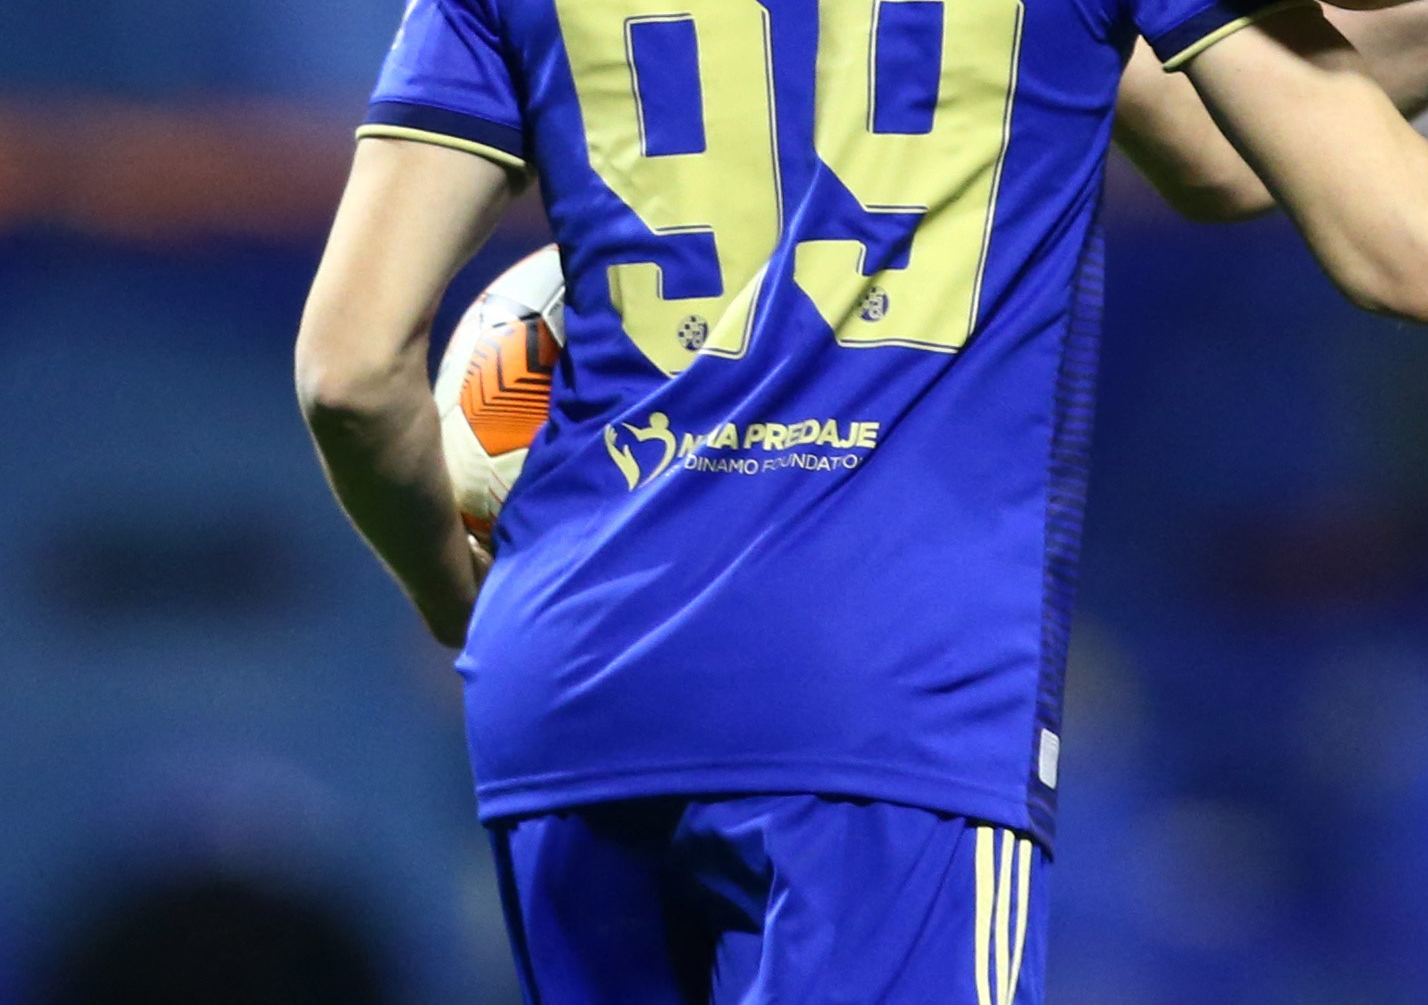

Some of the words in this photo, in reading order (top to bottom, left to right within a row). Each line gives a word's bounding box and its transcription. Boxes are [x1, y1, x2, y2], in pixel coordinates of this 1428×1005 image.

[743, 418, 881, 451] PREDAJE
[684, 454, 759, 475] DINAMO
[761, 453, 864, 473] FOUNDATO
